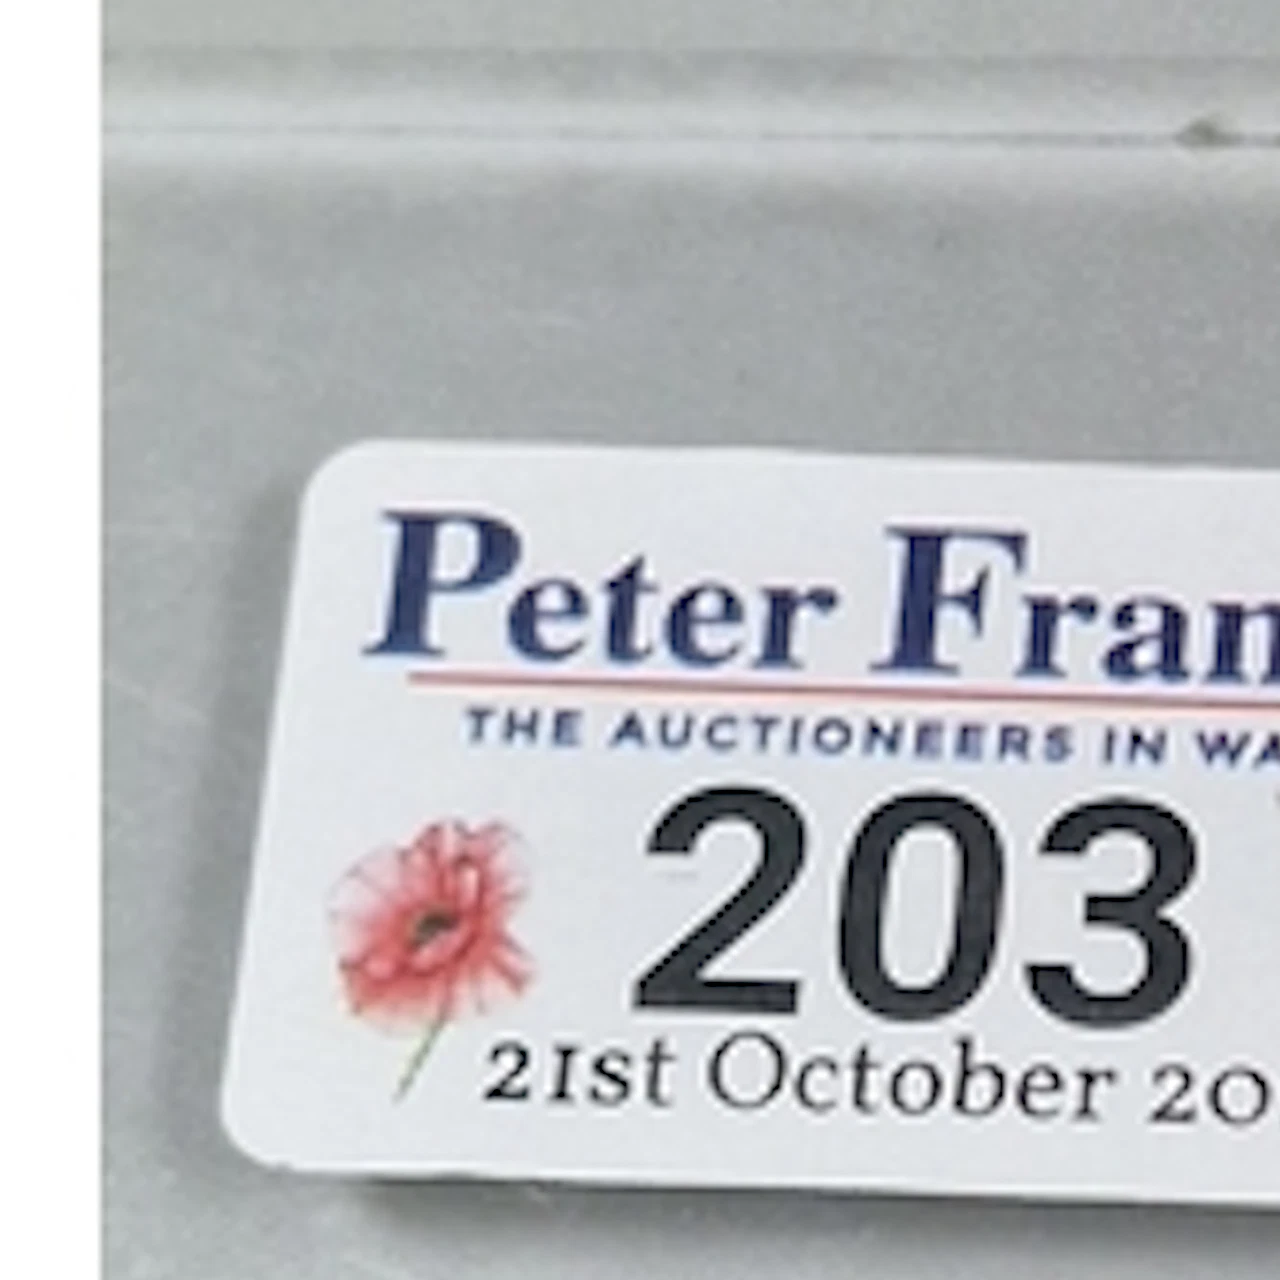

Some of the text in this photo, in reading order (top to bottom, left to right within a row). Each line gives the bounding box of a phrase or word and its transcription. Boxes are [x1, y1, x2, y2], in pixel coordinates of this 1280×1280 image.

[361, 510, 840, 670] Peter
[464, 706, 581, 747] THE
[610, 710, 1074, 763] AUCTIONEERS
[1101, 725, 1169, 767] IN
[631, 784, 1200, 1031] 203
[482, 1037, 674, 1109] 21st
[706, 1030, 1118, 1120] October
